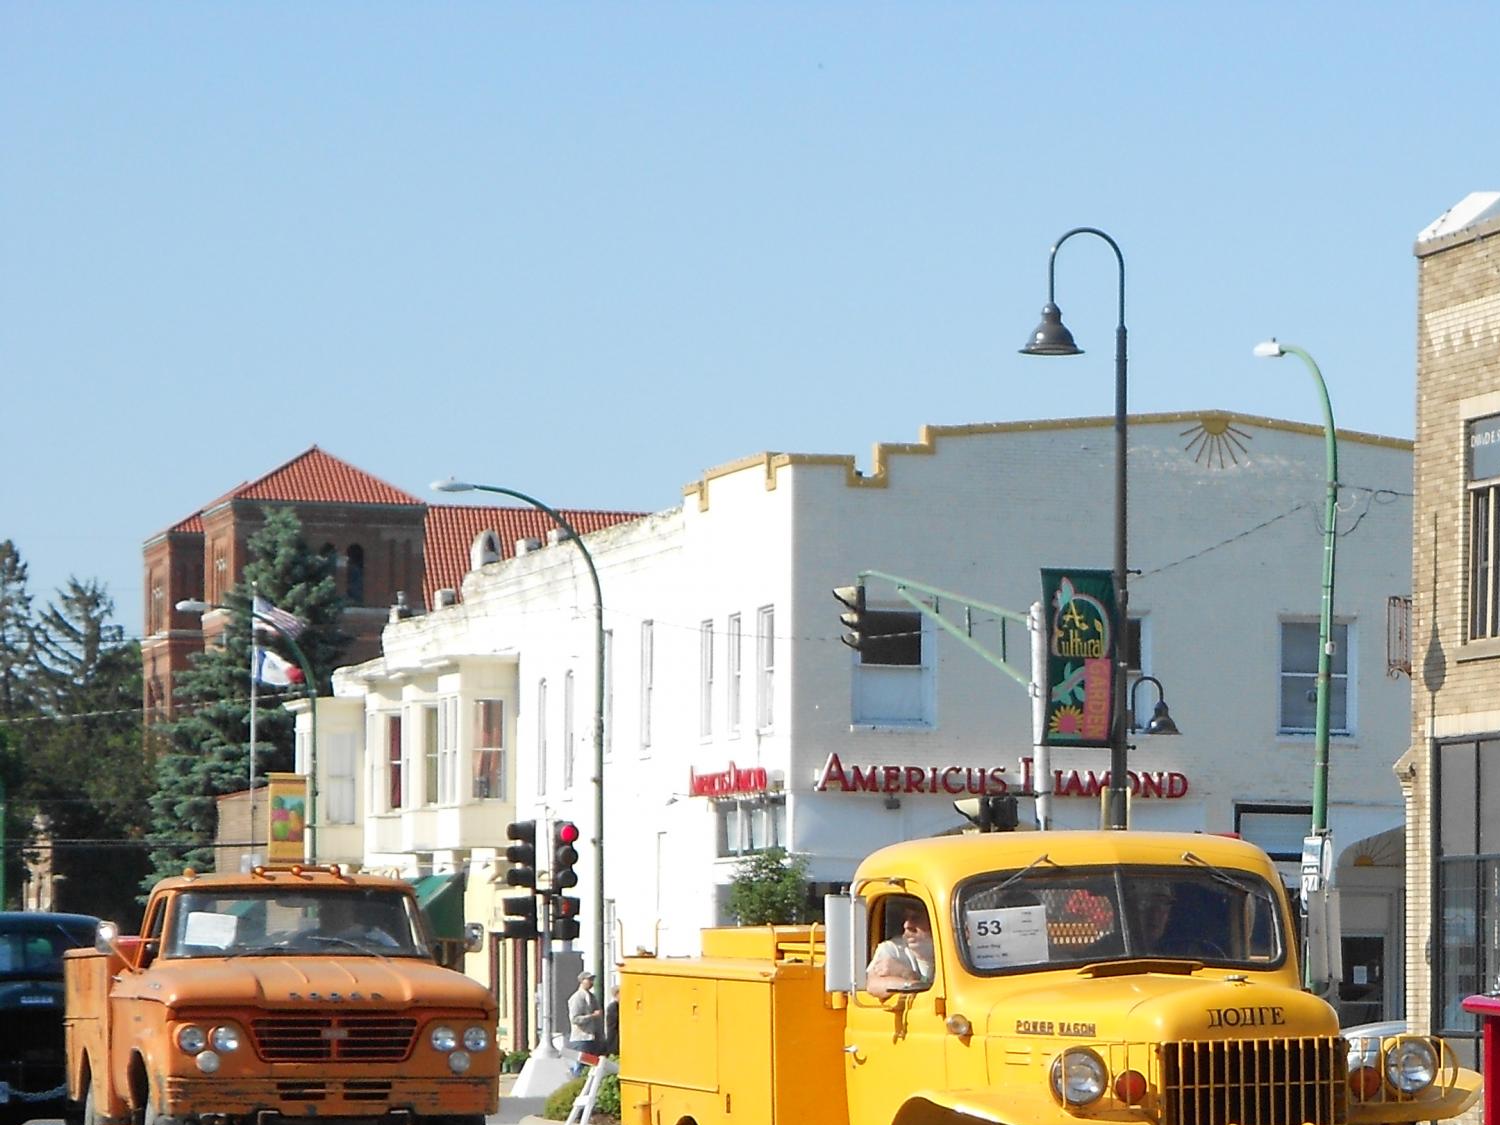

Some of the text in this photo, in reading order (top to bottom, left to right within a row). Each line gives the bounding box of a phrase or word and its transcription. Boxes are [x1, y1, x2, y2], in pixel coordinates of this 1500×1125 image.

[817, 752, 1008, 796] AMERICUS
[976, 920, 1002, 937] 53
[1016, 1020, 1097, 1037] POWER WAGON
